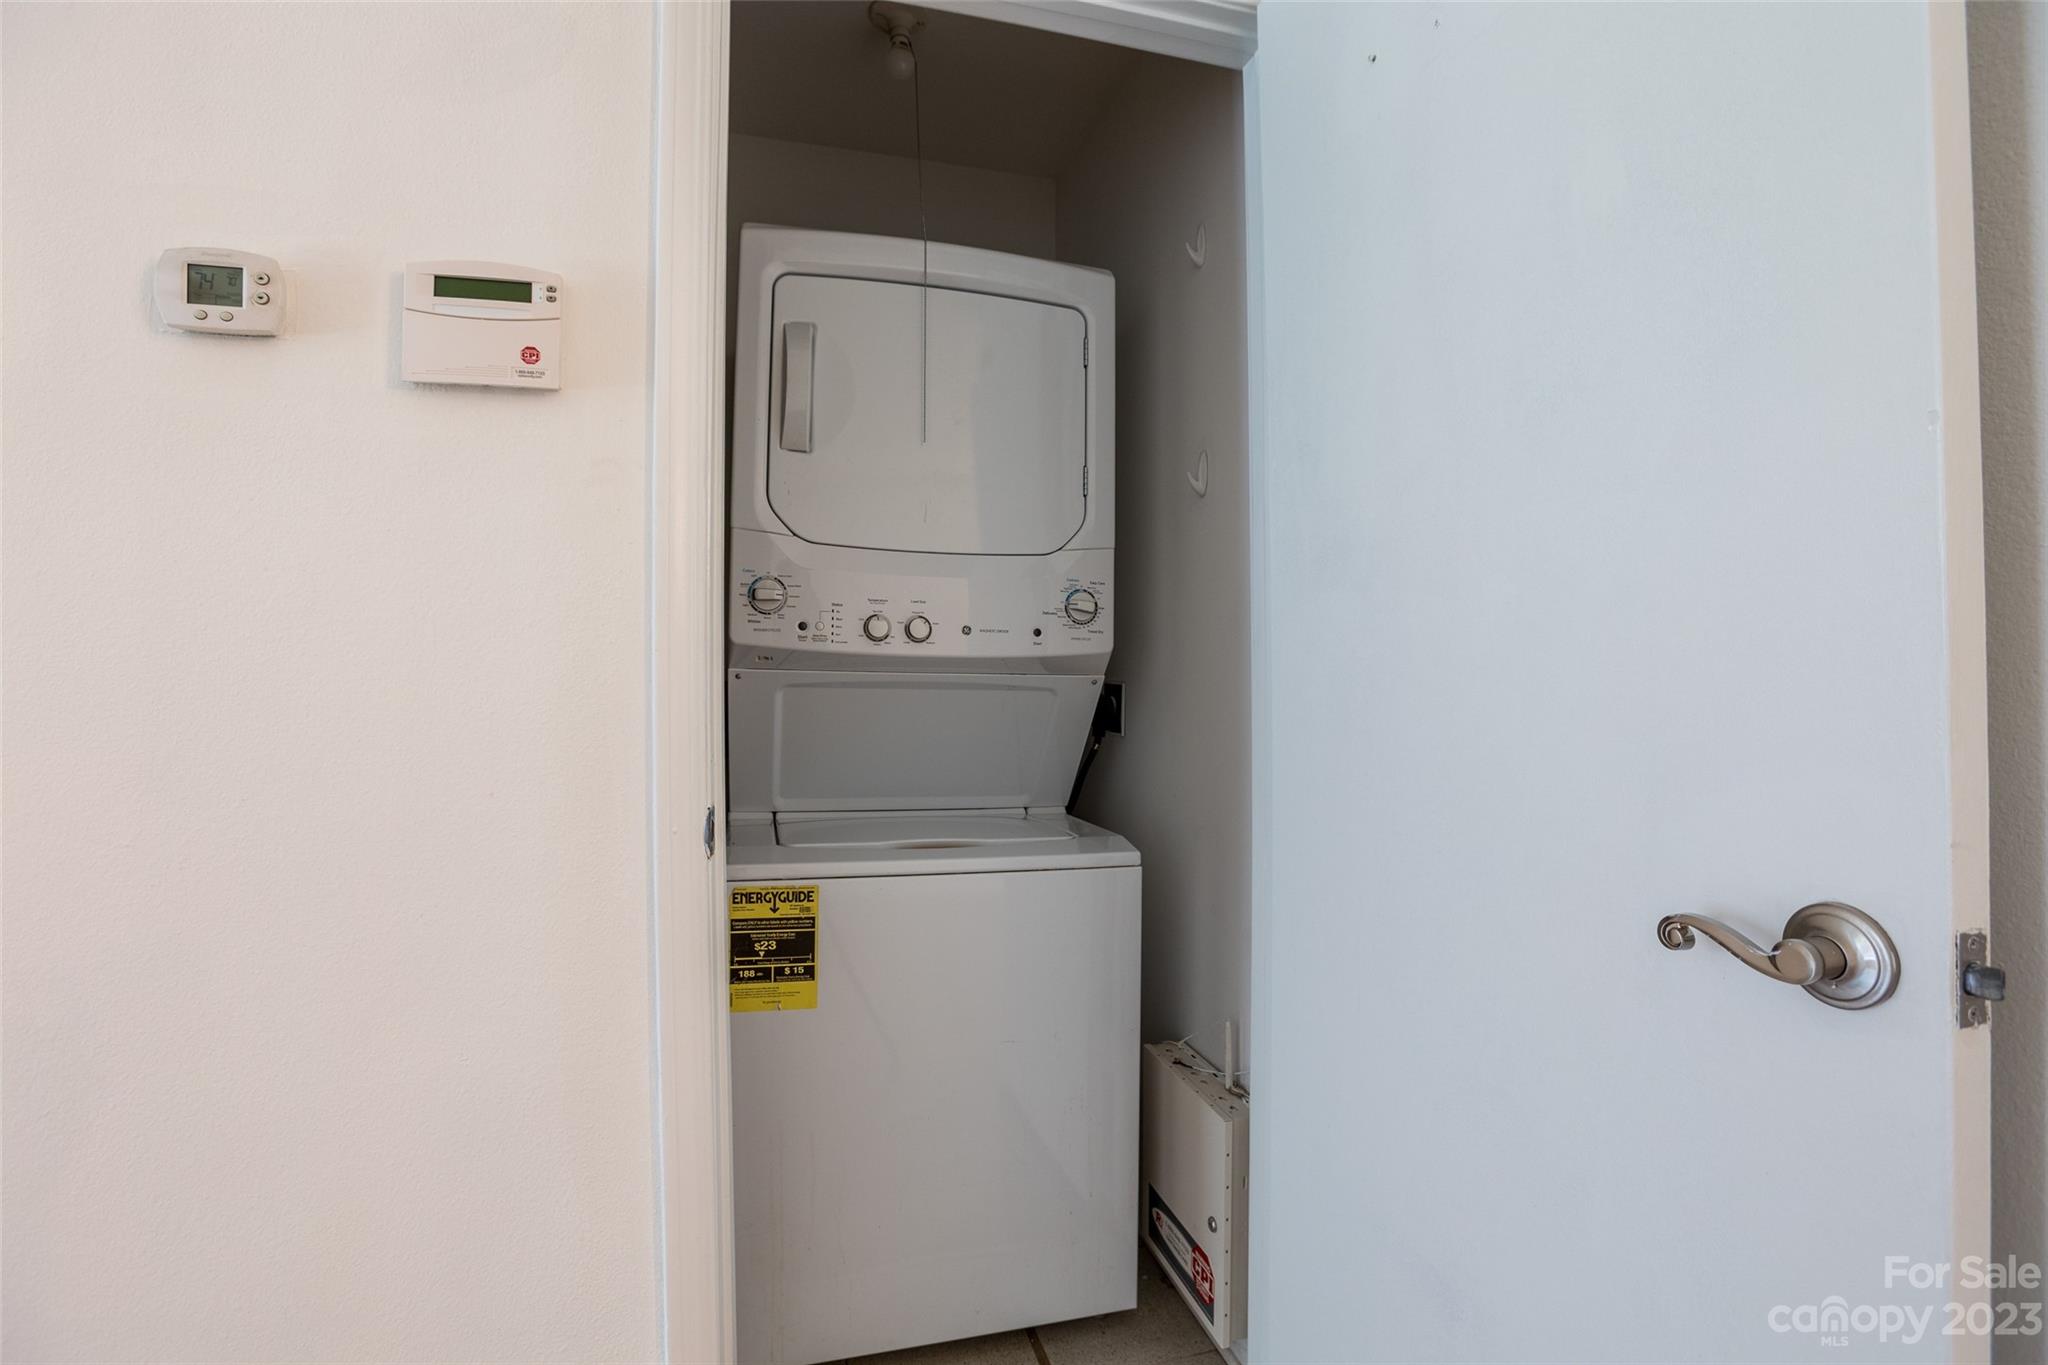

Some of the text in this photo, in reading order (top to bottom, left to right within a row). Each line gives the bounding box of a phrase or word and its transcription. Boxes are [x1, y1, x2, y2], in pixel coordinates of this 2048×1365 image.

[521, 351, 539, 359] CPI
[732, 891, 814, 905] ENERGYGUIDE
[754, 940, 776, 951] $23
[738, 970, 756, 978] 188
[1192, 1257, 1214, 1293] CPI
